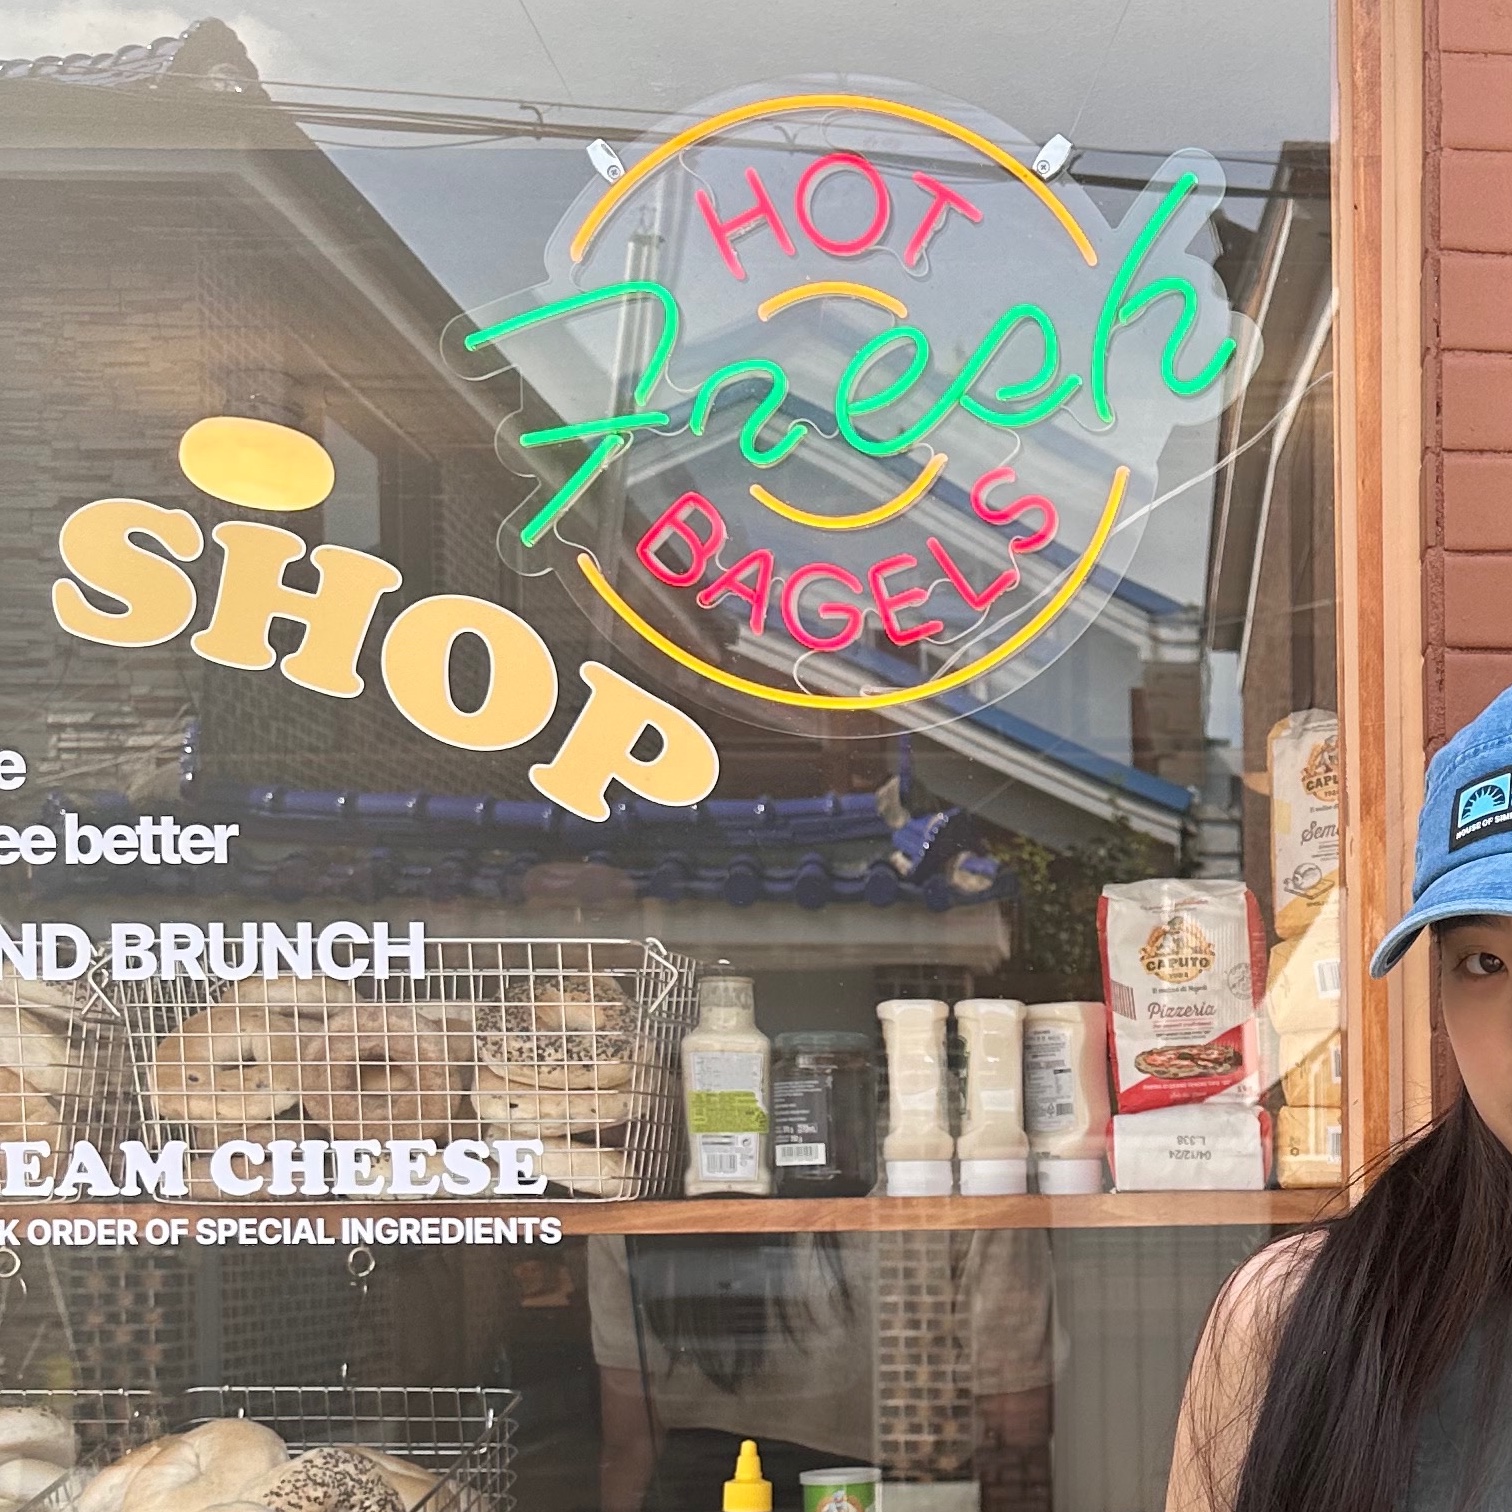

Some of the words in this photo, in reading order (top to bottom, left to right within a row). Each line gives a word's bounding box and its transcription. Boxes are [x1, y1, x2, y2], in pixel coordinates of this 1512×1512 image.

[694, 152, 983, 280] HOT
[464, 171, 1238, 547] Fresh
[636, 466, 1060, 653] BAGELS
[52, 497, 720, 823] SHOP
[65, 812, 239, 865] better
[1482, 817, 1493, 827] OF
[112, 920, 425, 981] BRUNCH
[1146, 957, 1211, 972] CAPUTO
[1147, 1001, 1216, 1019] Pizzeria
[210, 1138, 548, 1196] CHEESE
[27, 1218, 139, 1246] ORDER
[145, 1218, 189, 1246] OF
[196, 1217, 335, 1246] SPECIAL
[342, 1216, 563, 1245] INGREDIENTS
